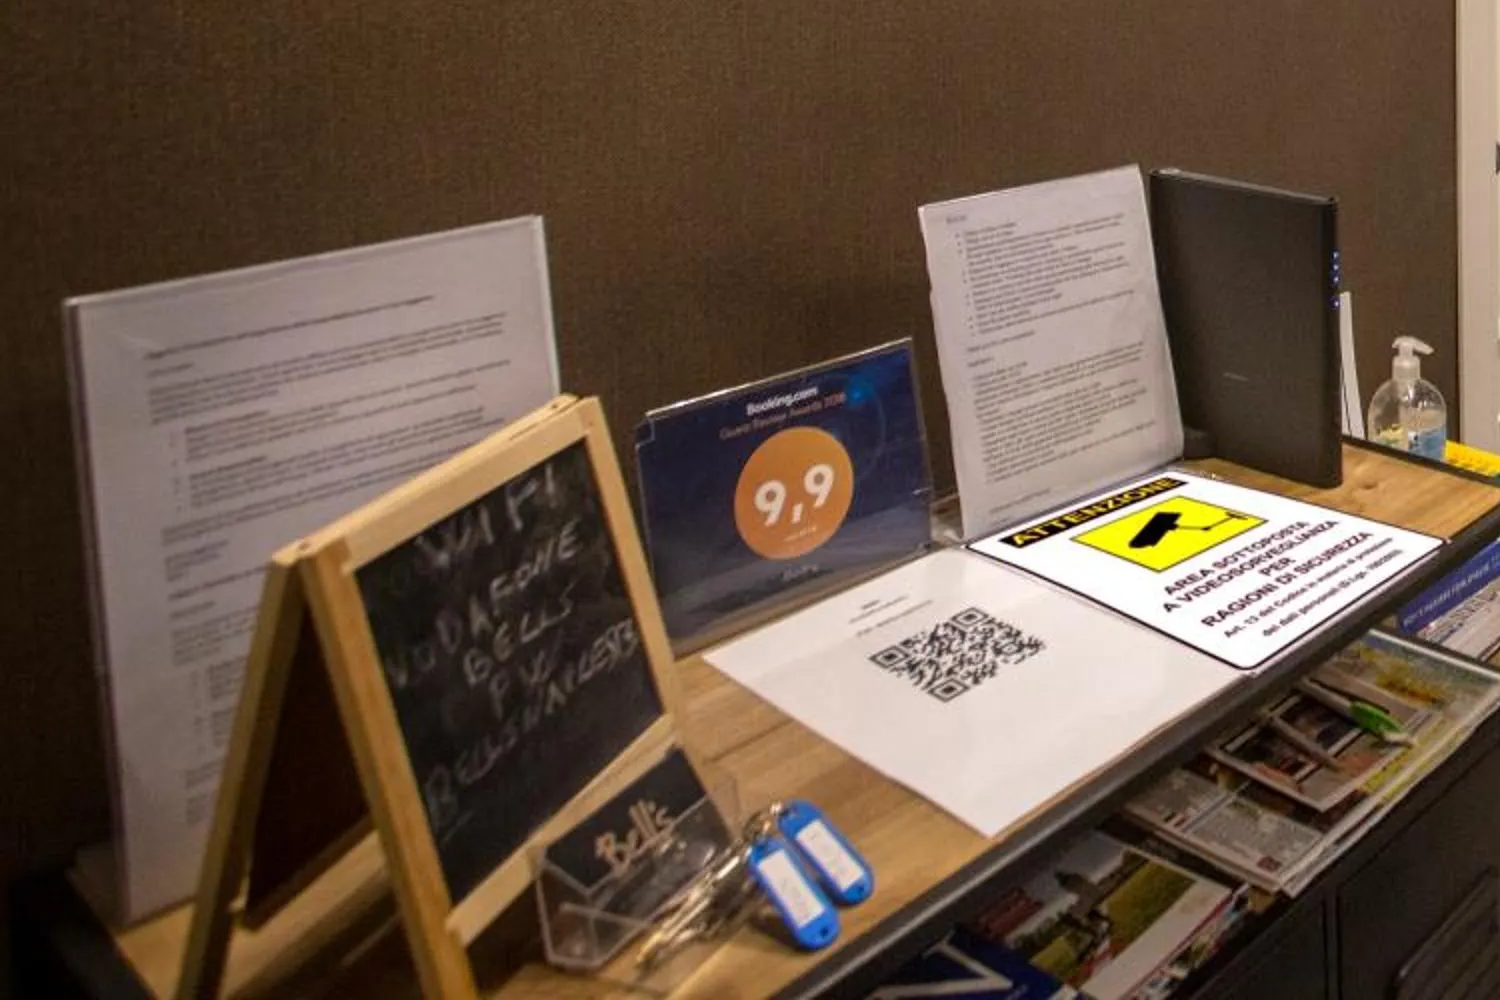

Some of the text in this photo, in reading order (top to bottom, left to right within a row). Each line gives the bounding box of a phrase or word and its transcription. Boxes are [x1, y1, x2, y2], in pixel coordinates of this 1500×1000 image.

[746, 386, 818, 416] Booking.com
[754, 464, 834, 528] 9,9
[1012, 477, 1174, 547] ATTENZIONE
[1163, 602, 1181, 613] A
[1176, 520, 1339, 603] VIDEOSORVEGLIANZA
[1164, 568, 1215, 596] AREA
[1212, 520, 1310, 569] SOTTOPOSTA
[1201, 583, 1280, 628] RAGIONI
[1276, 572, 1297, 585] DI
[1294, 531, 1374, 575] SICUREZZA
[1258, 556, 1297, 578] PER
